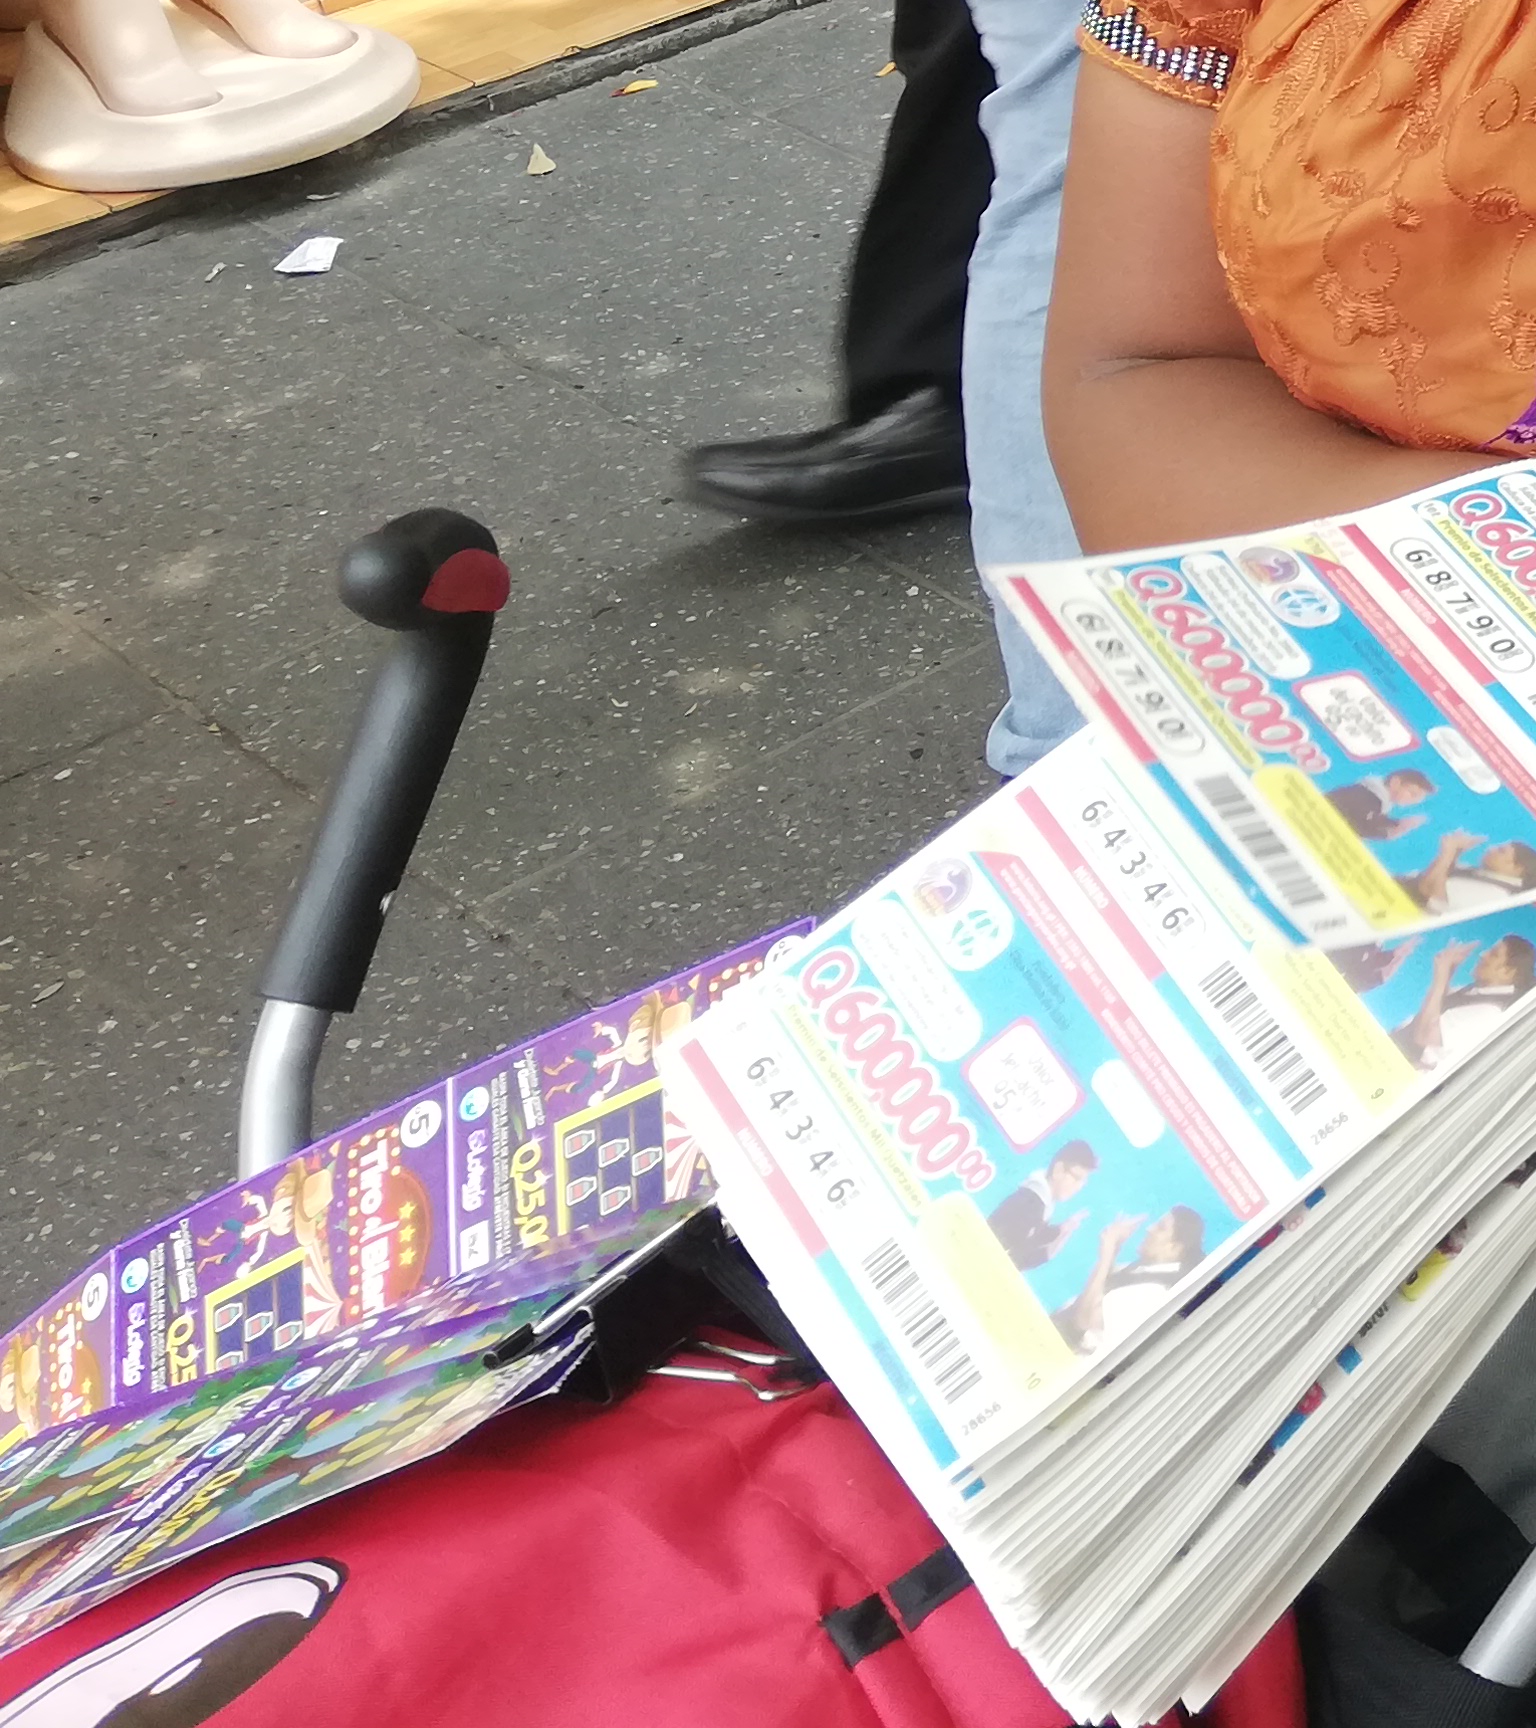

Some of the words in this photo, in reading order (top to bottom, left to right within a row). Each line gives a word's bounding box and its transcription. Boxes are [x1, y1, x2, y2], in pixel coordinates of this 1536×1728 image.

[1436, 518, 1475, 551] Premio
[1466, 549, 1486, 563] de
[1477, 561, 1533, 612] Seiscientos
[1309, 1109, 1350, 1146] 28656
[1019, 1369, 1043, 1395] 10
[959, 1397, 1003, 1438] 28656
